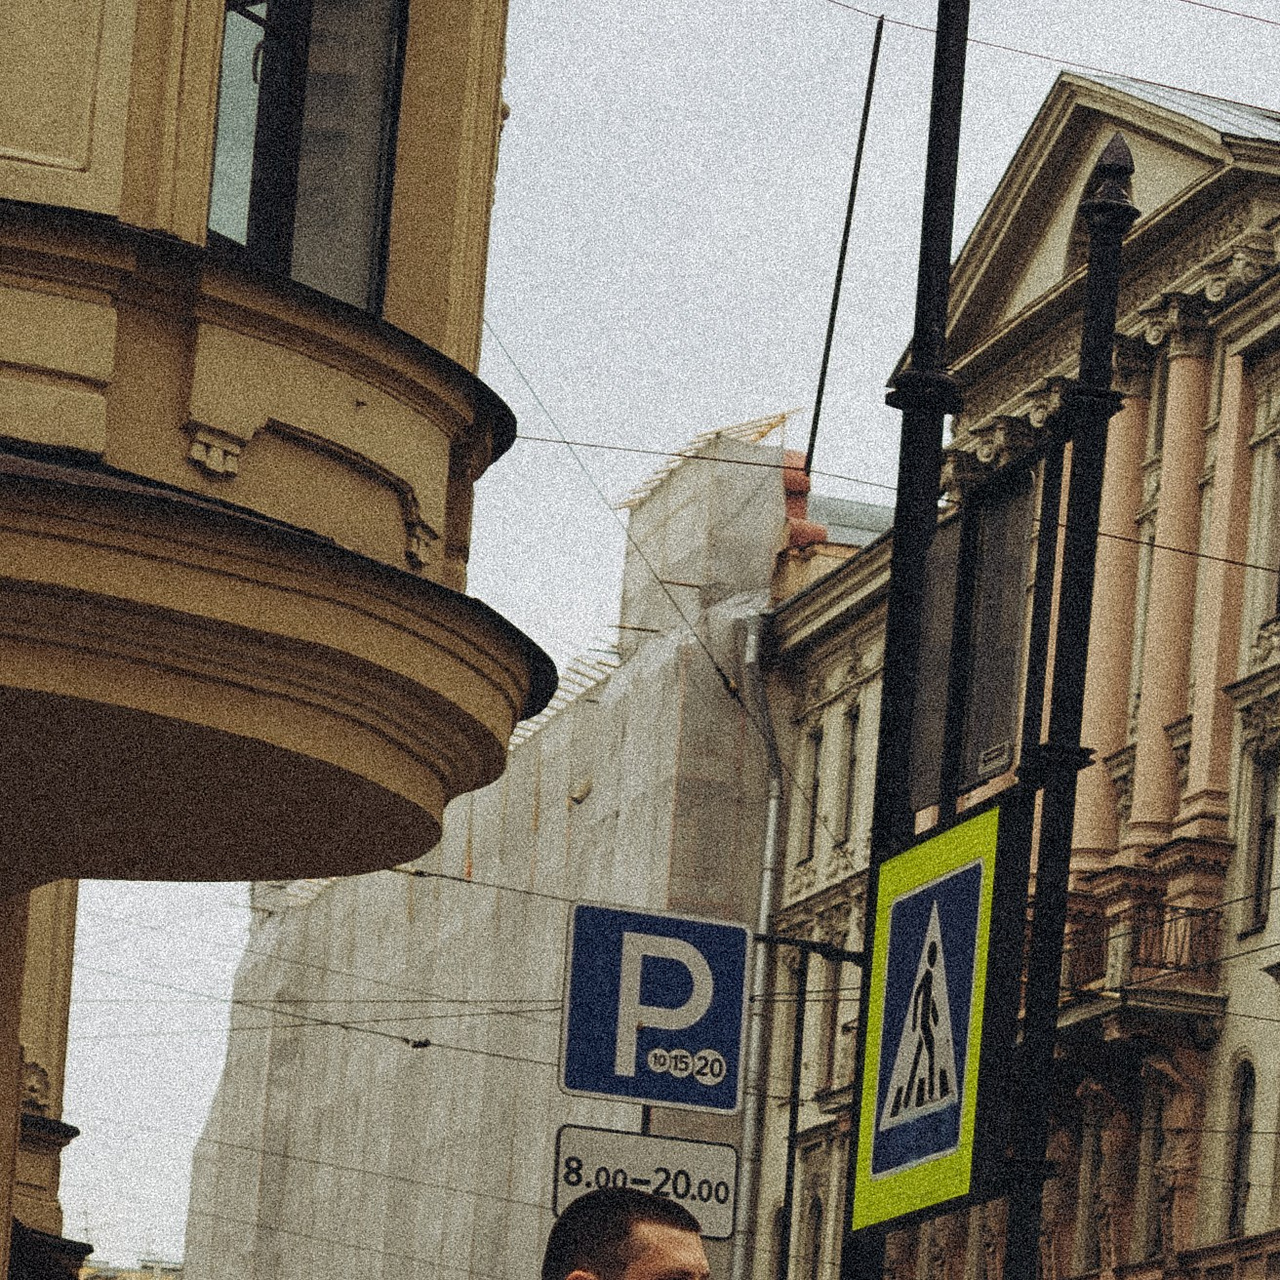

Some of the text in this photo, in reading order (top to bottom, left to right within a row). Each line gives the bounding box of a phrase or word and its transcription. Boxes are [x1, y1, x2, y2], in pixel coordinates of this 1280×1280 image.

[615, 931, 713, 1078] P
[653, 1052, 723, 1078] 10 15 20
